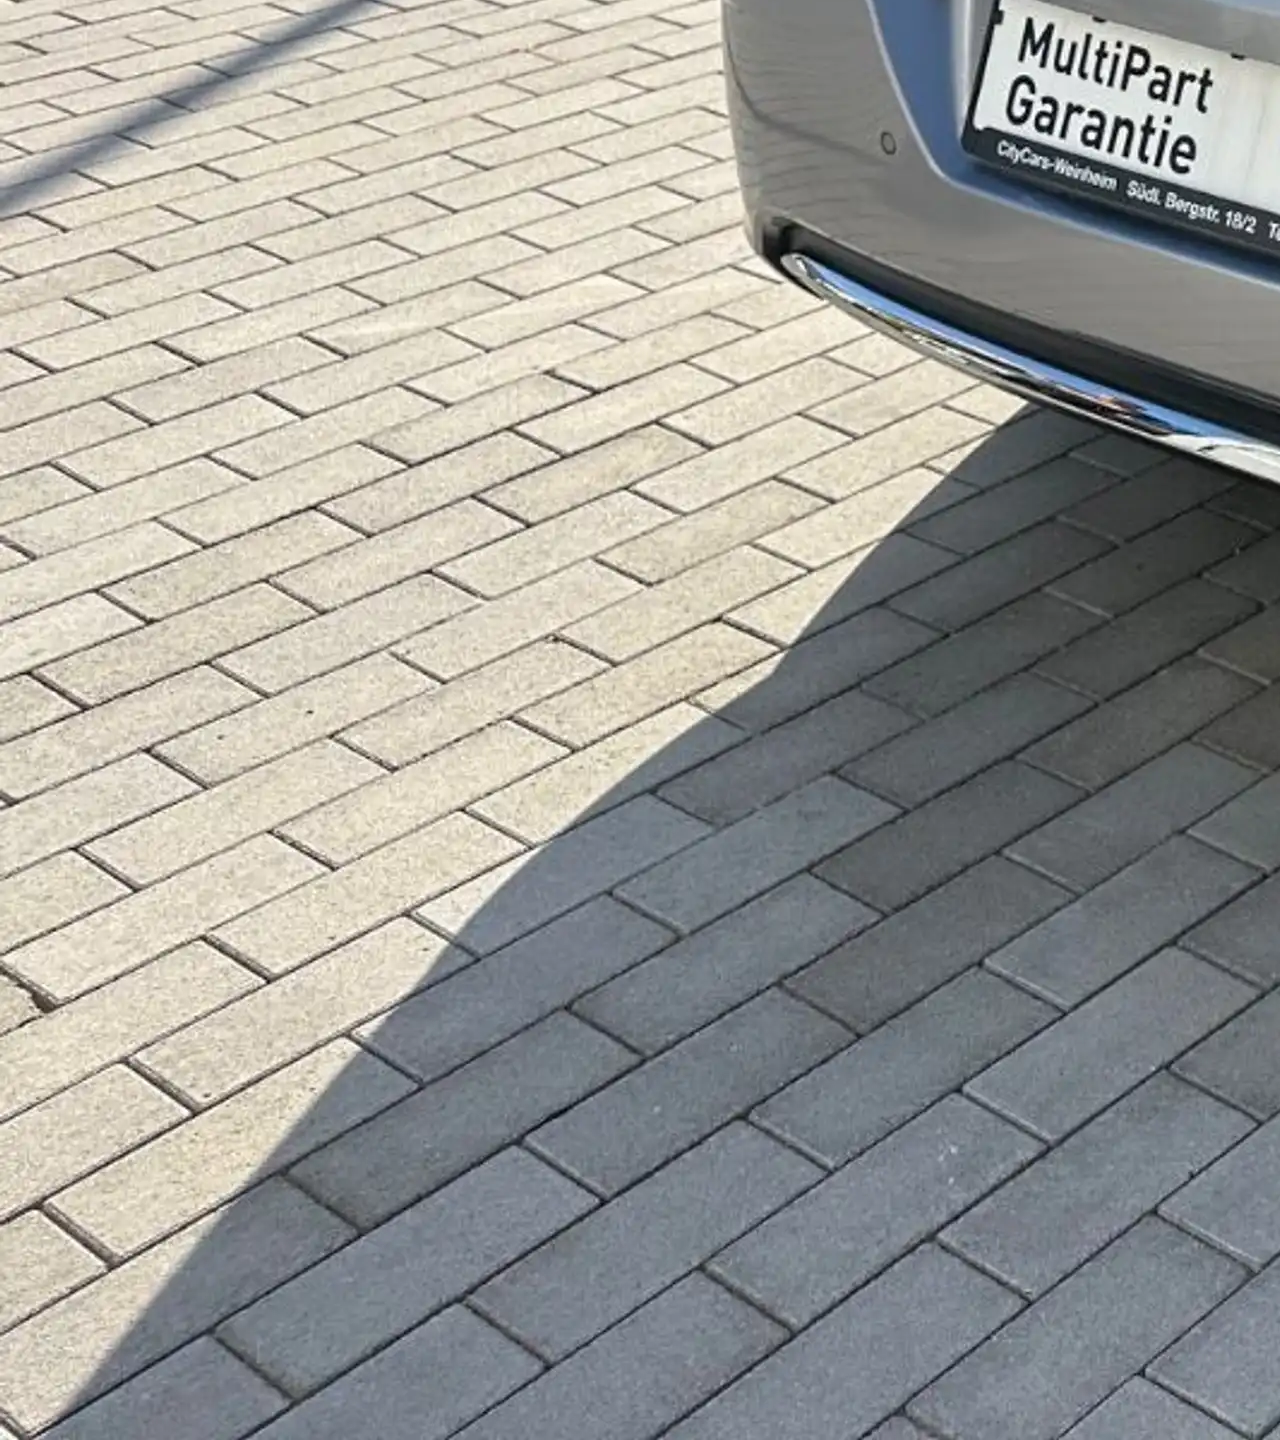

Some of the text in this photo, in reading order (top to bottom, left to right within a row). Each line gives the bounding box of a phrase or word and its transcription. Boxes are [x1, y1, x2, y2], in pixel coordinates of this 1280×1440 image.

[1018, 16, 1213, 114] MultiPart
[1006, 74, 1197, 175] Garantie
[1164, 191, 1221, 224] Bergstr.
[1224, 210, 1258, 235] 18/2
